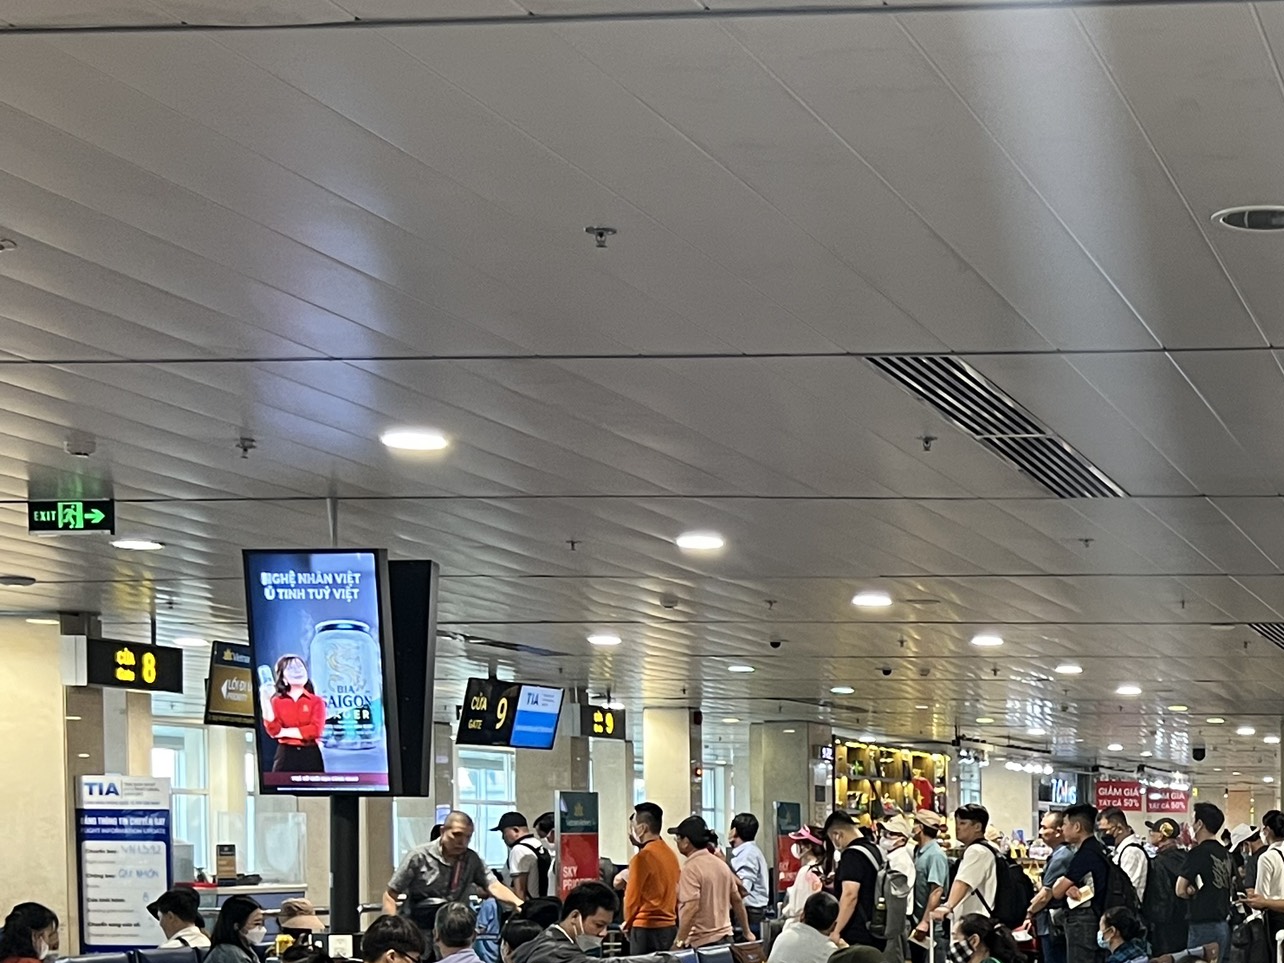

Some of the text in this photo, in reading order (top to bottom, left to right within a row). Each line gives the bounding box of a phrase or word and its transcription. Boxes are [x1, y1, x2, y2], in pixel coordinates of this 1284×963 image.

[34, 511, 56, 521] EXIT
[141, 652, 156, 684] 8
[527, 693, 539, 706] TIA
[495, 697, 507, 730] 9
[605, 712, 614, 734] 9
[84, 783, 119, 796] TIA
[1124, 787, 1139, 797] GIÁ
[1123, 799, 1139, 807] 50%
[563, 866, 578, 878] SKY
